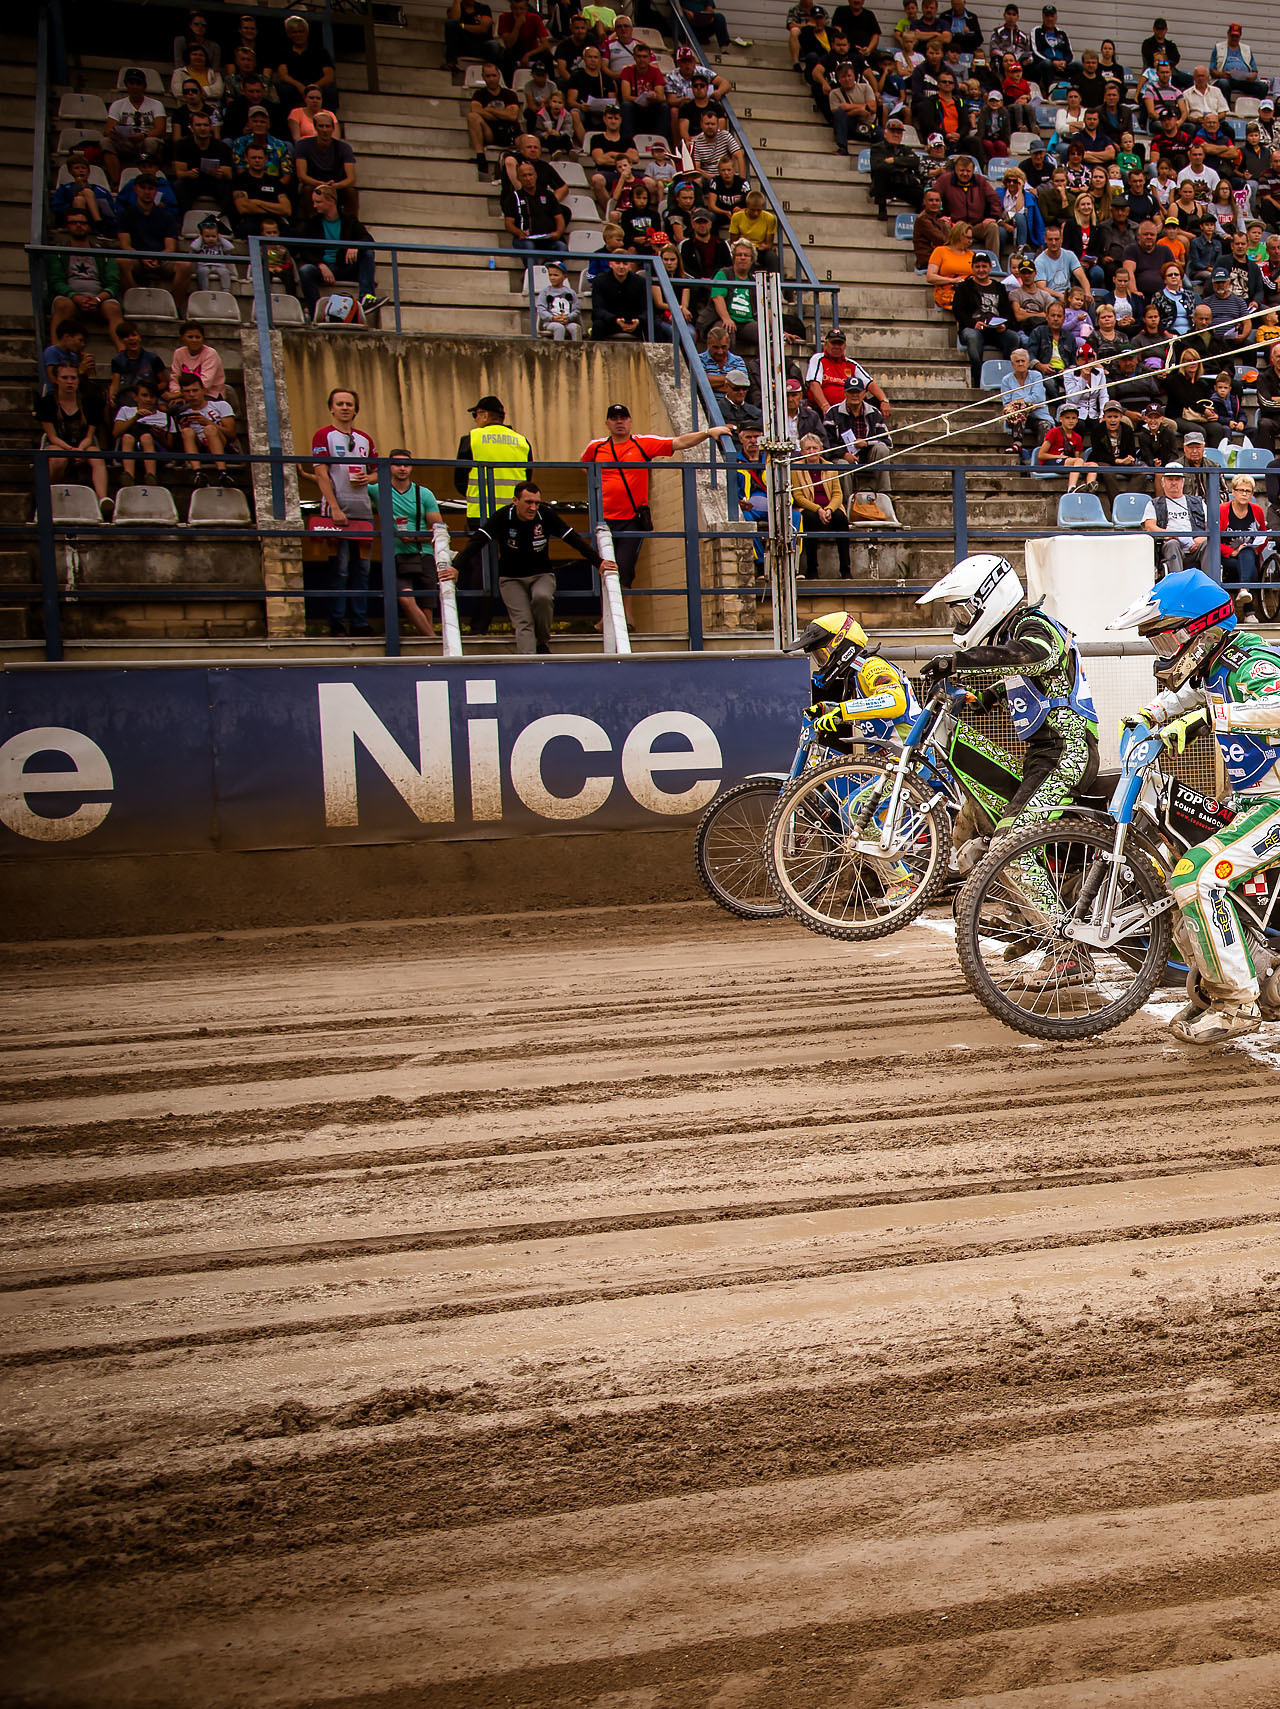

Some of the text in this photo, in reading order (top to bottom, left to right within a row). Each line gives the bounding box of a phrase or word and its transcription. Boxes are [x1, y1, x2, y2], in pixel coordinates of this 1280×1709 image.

[744, 108, 752, 117] 13
[759, 138, 767, 147] 12
[776, 166, 783, 176] 11
[782, 200, 790, 211] 10
[808, 234, 815, 244] 9
[826, 269, 832, 280] 8
[1251, 452, 1258, 460] 5
[64, 488, 71, 496] 1
[142, 488, 149, 496] 2
[1129, 496, 1136, 505] 2
[979, 557, 1012, 599] SCO
[1188, 600, 1235, 635] SCO
[1009, 697, 1028, 715] ce
[860, 720, 875, 735] ce
[1122, 735, 1150, 761] ice
[1222, 742, 1246, 762] ce
[318, 680, 724, 828] Nice
[1176, 786, 1203, 805] TOP
[1216, 895, 1229, 932] REALL
